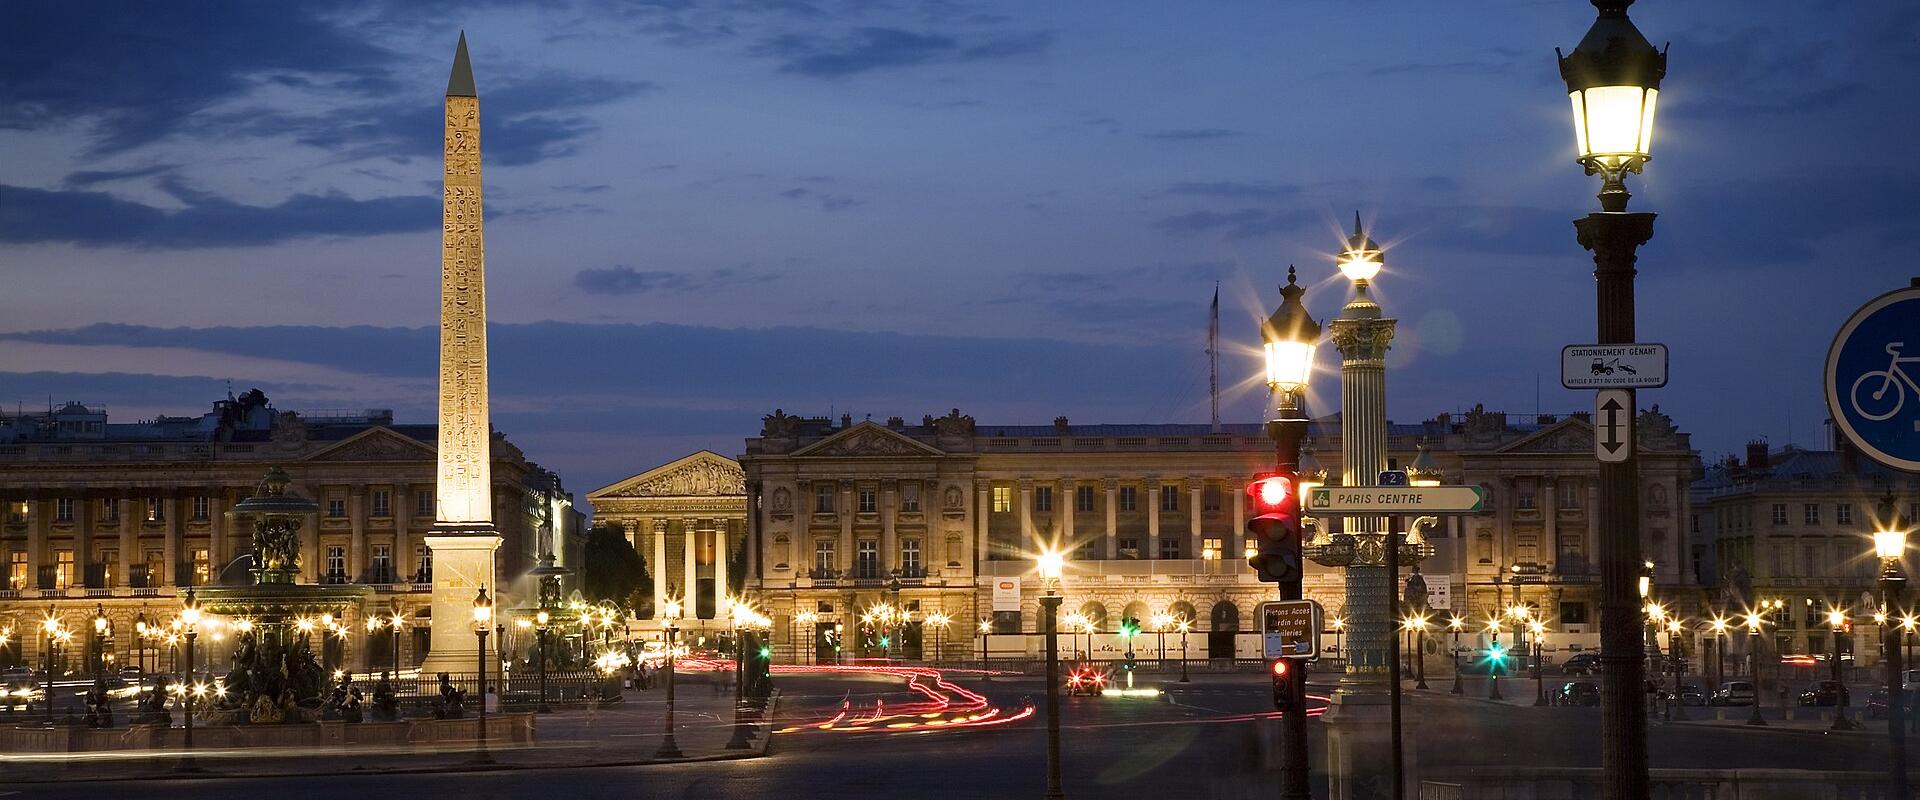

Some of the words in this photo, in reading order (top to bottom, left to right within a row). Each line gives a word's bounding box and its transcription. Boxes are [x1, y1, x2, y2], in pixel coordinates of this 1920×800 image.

[1571, 348, 1626, 357] STATIONNEMENT
[1390, 474, 1397, 483] 2
[1337, 494, 1372, 504] PARIS
[1378, 494, 1423, 504] CENTRE
[1294, 618, 1306, 626] des
